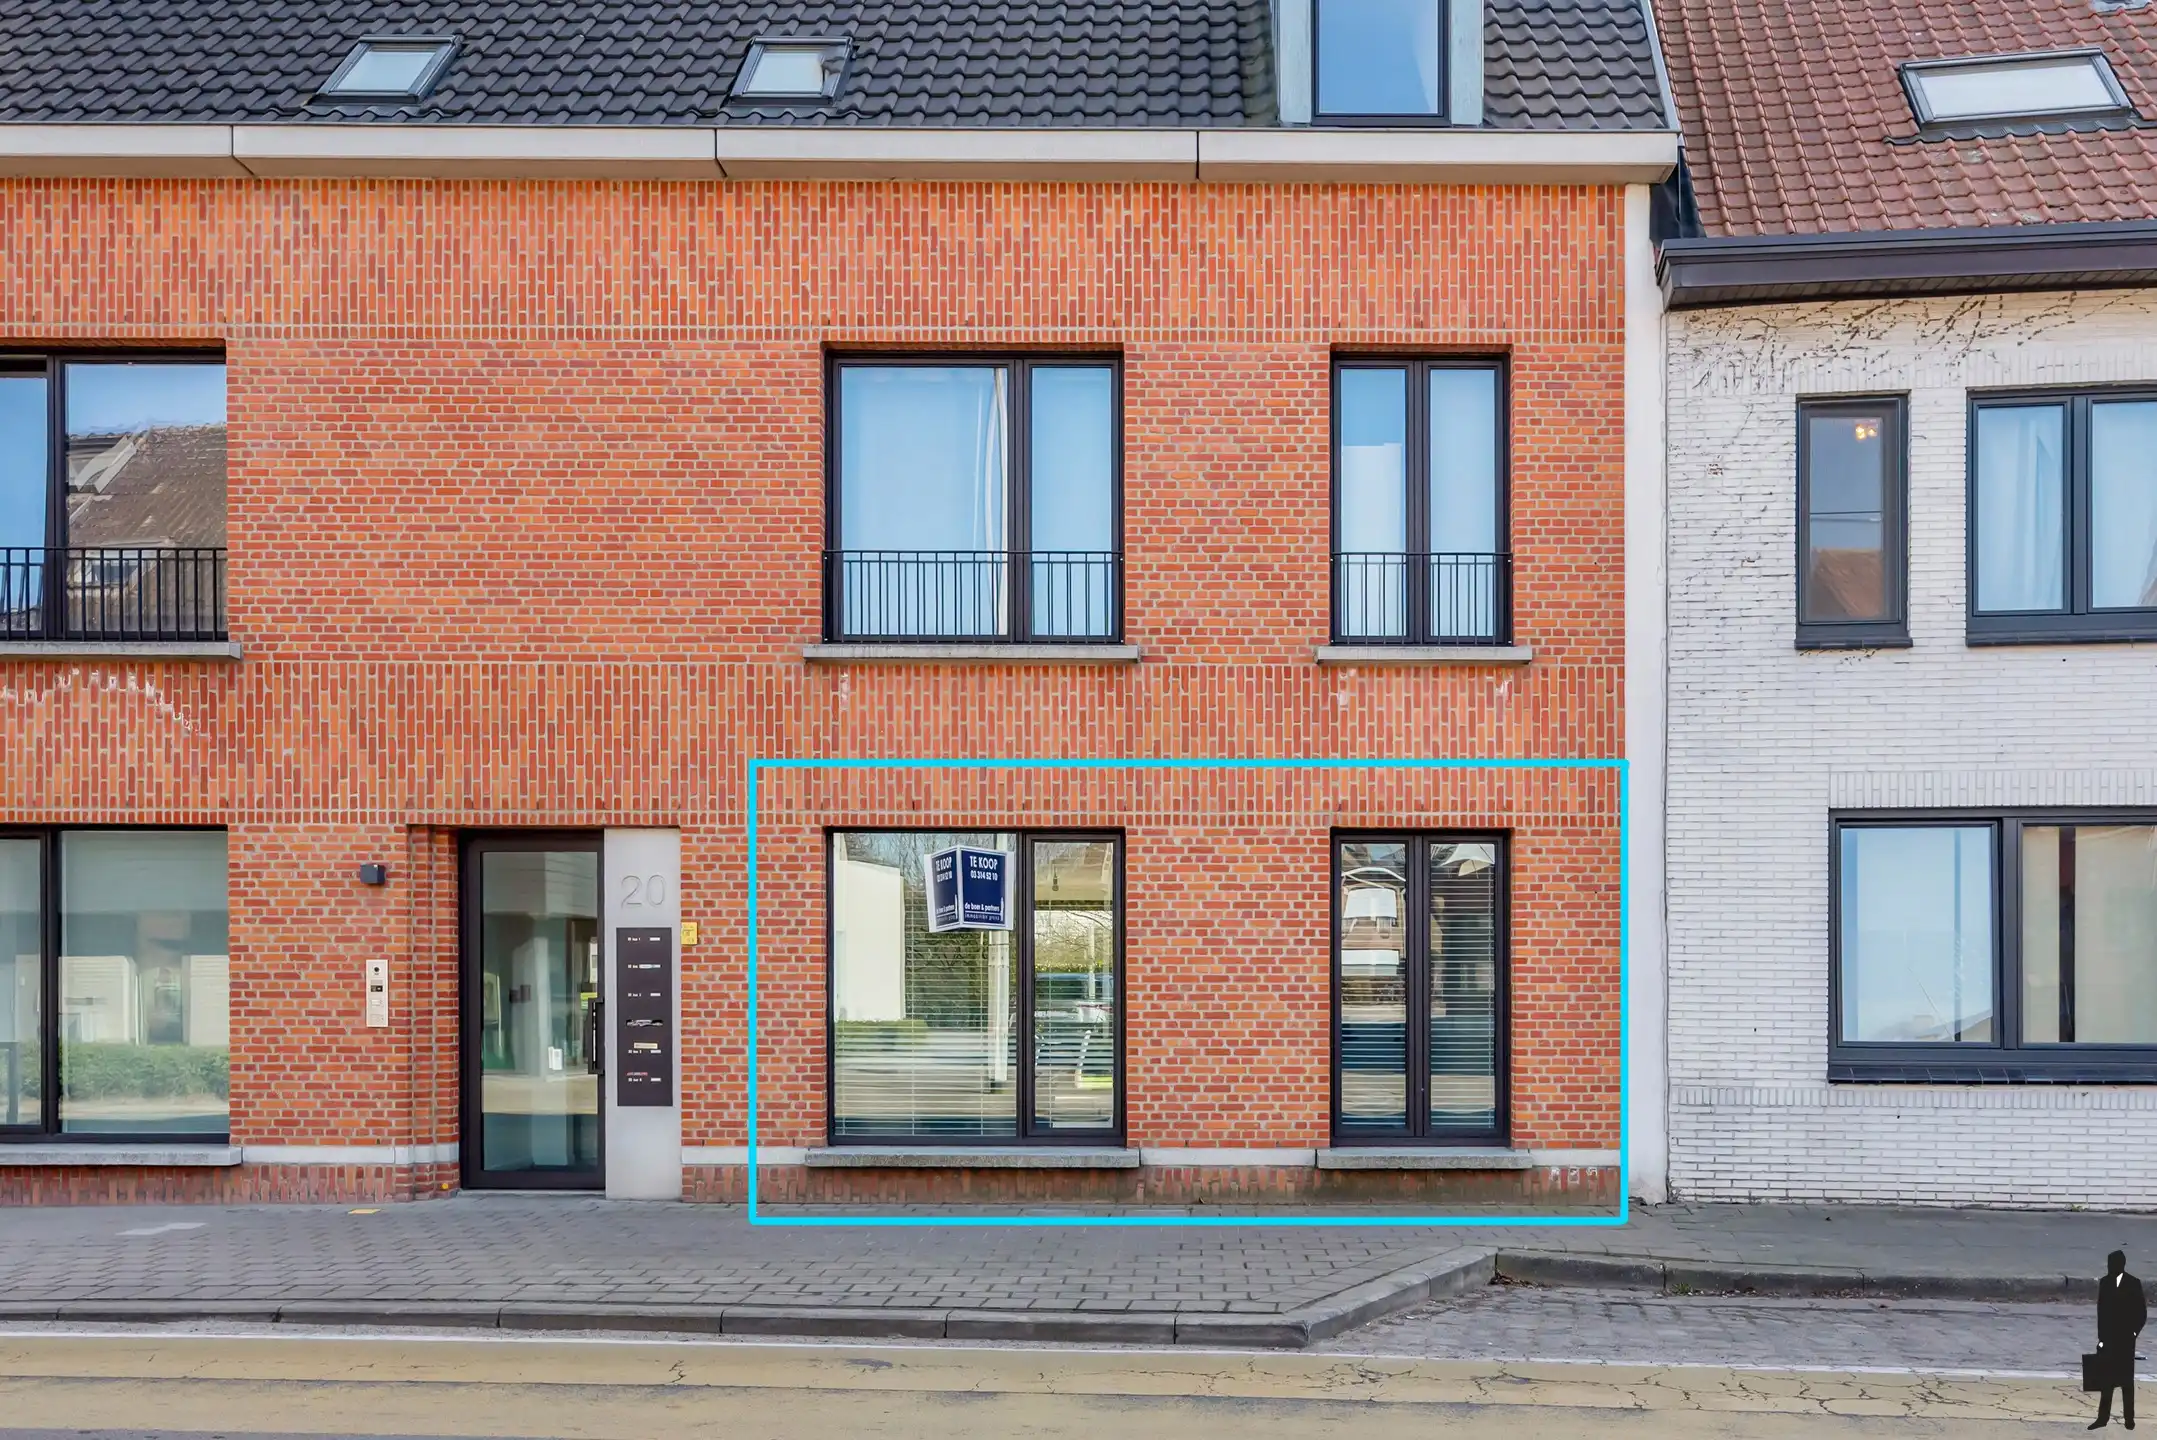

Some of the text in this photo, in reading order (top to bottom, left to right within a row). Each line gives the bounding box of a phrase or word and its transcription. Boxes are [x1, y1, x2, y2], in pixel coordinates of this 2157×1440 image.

[969, 855, 998, 870] TE KOOP
[992, 872, 998, 881] 10
[621, 874, 666, 909] 20
